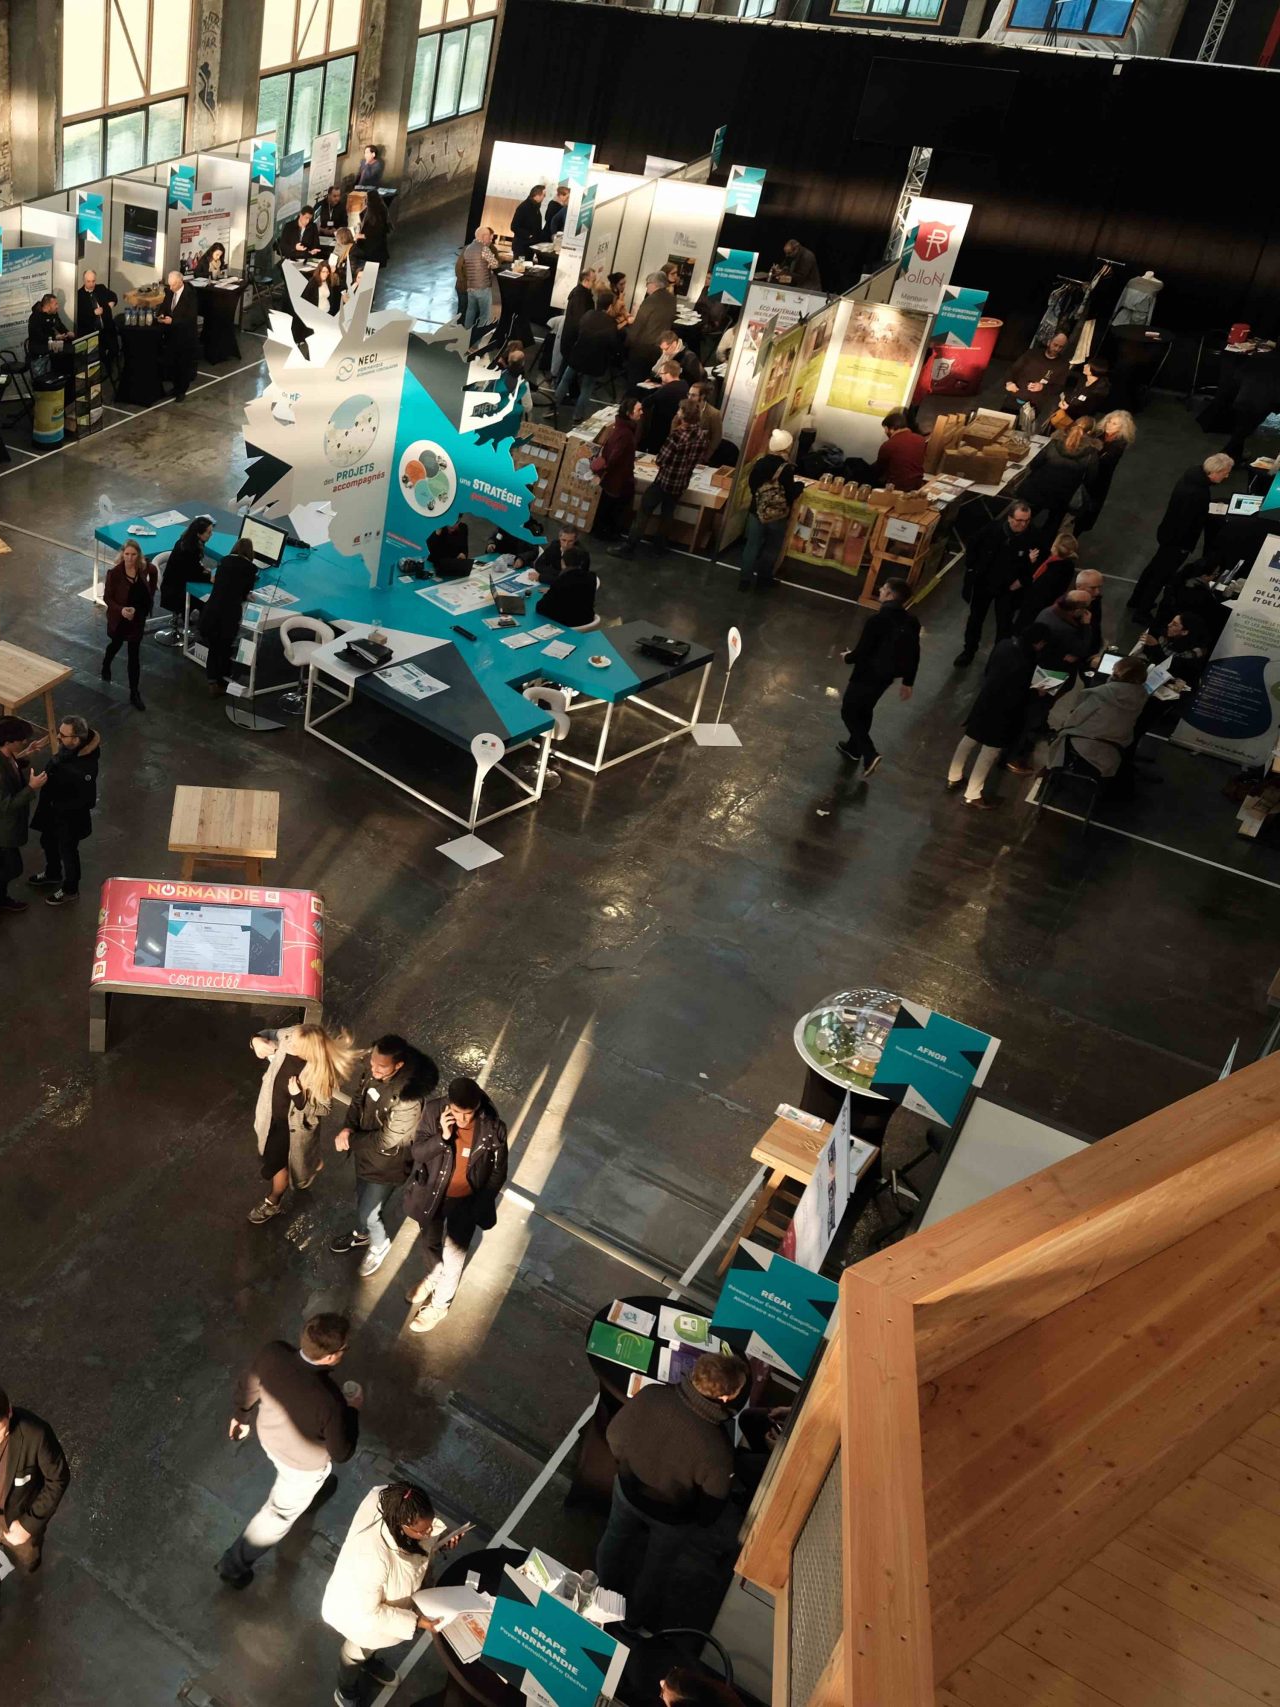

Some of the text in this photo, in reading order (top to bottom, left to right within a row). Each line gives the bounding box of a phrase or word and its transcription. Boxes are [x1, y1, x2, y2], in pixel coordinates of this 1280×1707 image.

[358, 352, 378, 366] NECI
[332, 472, 386, 493] accompagnés
[336, 462, 375, 482] PROJETS
[472, 478, 523, 508] STRATÉGIE
[148, 882, 260, 902] NORMANDIE
[168, 972, 241, 990] connectée
[916, 1045, 948, 1063] AFNOR
[750, 1295, 764, 1304] pour
[760, 1289, 792, 1311] RÉGAL
[733, 1296, 767, 1315] Alimentaire
[776, 1316, 810, 1336] Normandie
[513, 1625, 580, 1676] NORMANDIE
[530, 1626, 568, 1656] GRAPE
[500, 1626, 588, 1692] Foyers témoins Zéro Déchet
